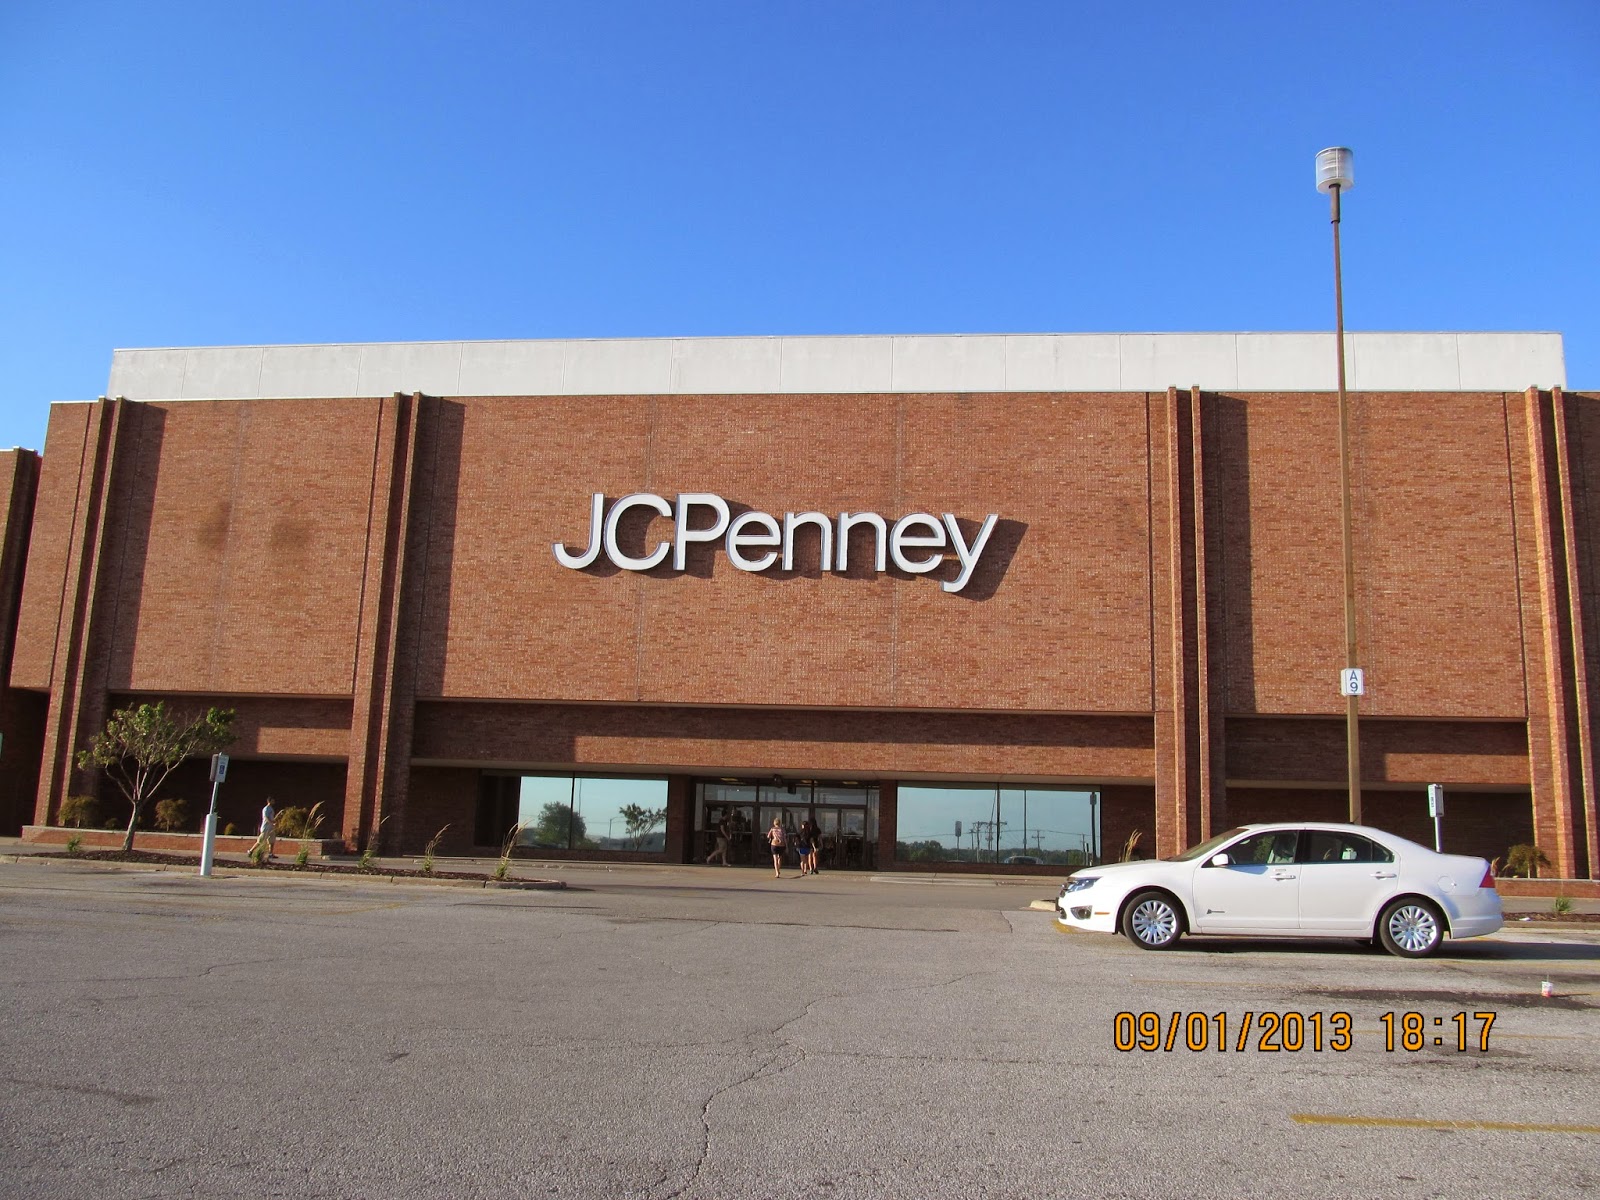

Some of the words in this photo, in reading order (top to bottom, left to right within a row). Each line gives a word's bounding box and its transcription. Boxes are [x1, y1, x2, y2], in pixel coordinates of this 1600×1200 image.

[551, 493, 999, 592] JCPenney
[1349, 669, 1359, 681] A
[1349, 681, 1359, 692] 9
